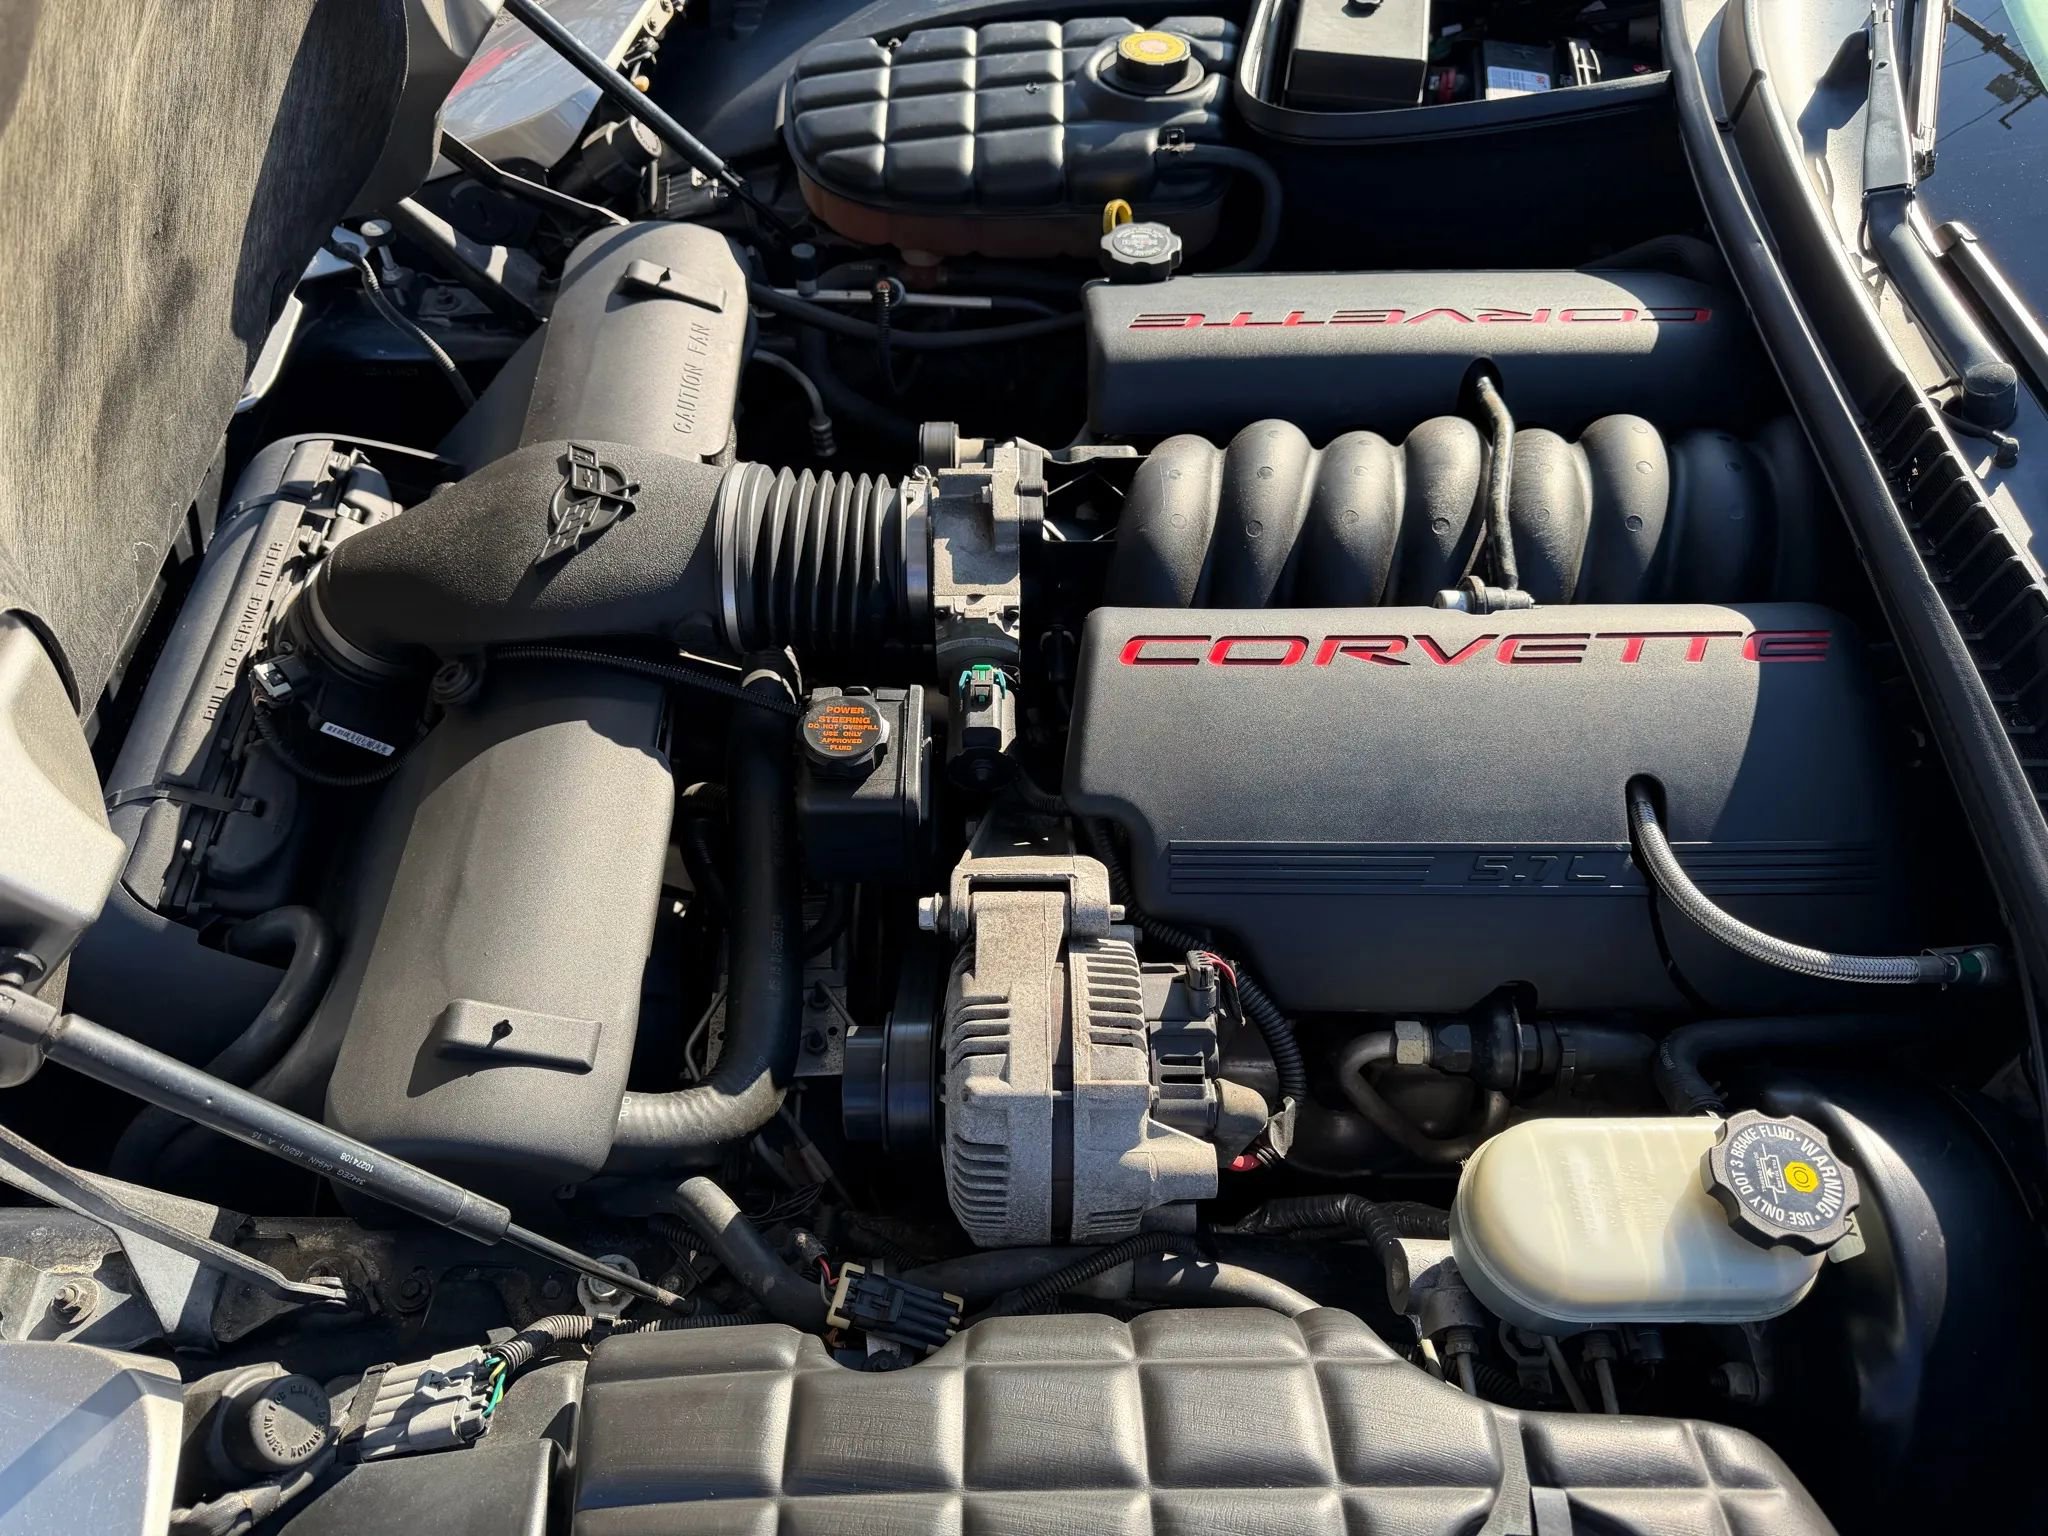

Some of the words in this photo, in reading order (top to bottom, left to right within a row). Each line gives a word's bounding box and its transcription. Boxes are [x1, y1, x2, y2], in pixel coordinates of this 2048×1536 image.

[1126, 307, 1713, 330] CORVETTE
[687, 322, 711, 356] FAN
[673, 362, 704, 434] CAUTION
[203, 685, 229, 721] PULL
[220, 657, 237, 676] TO
[231, 594, 263, 653] SERVICE
[256, 542, 284, 587] FILTER
[1118, 630, 1831, 667] CORVETTE
[818, 716, 871, 724] STEERING
[826, 706, 865, 714] POWER
[1468, 855, 1607, 882] 5.7L
[1731, 1128, 1761, 1159] BRAKE
[1758, 1125, 1796, 1141] FLUID
[340, 1152, 375, 1173] 10274108
[1731, 1159, 1744, 1168] 3
[1731, 1171, 1754, 1195] DOT
[1801, 1138, 1842, 1218] WARNING
[1749, 1195, 1785, 1221] ONLY
[1789, 1210, 1815, 1226] USE
[264, 1415, 284, 1456] REMOVE
